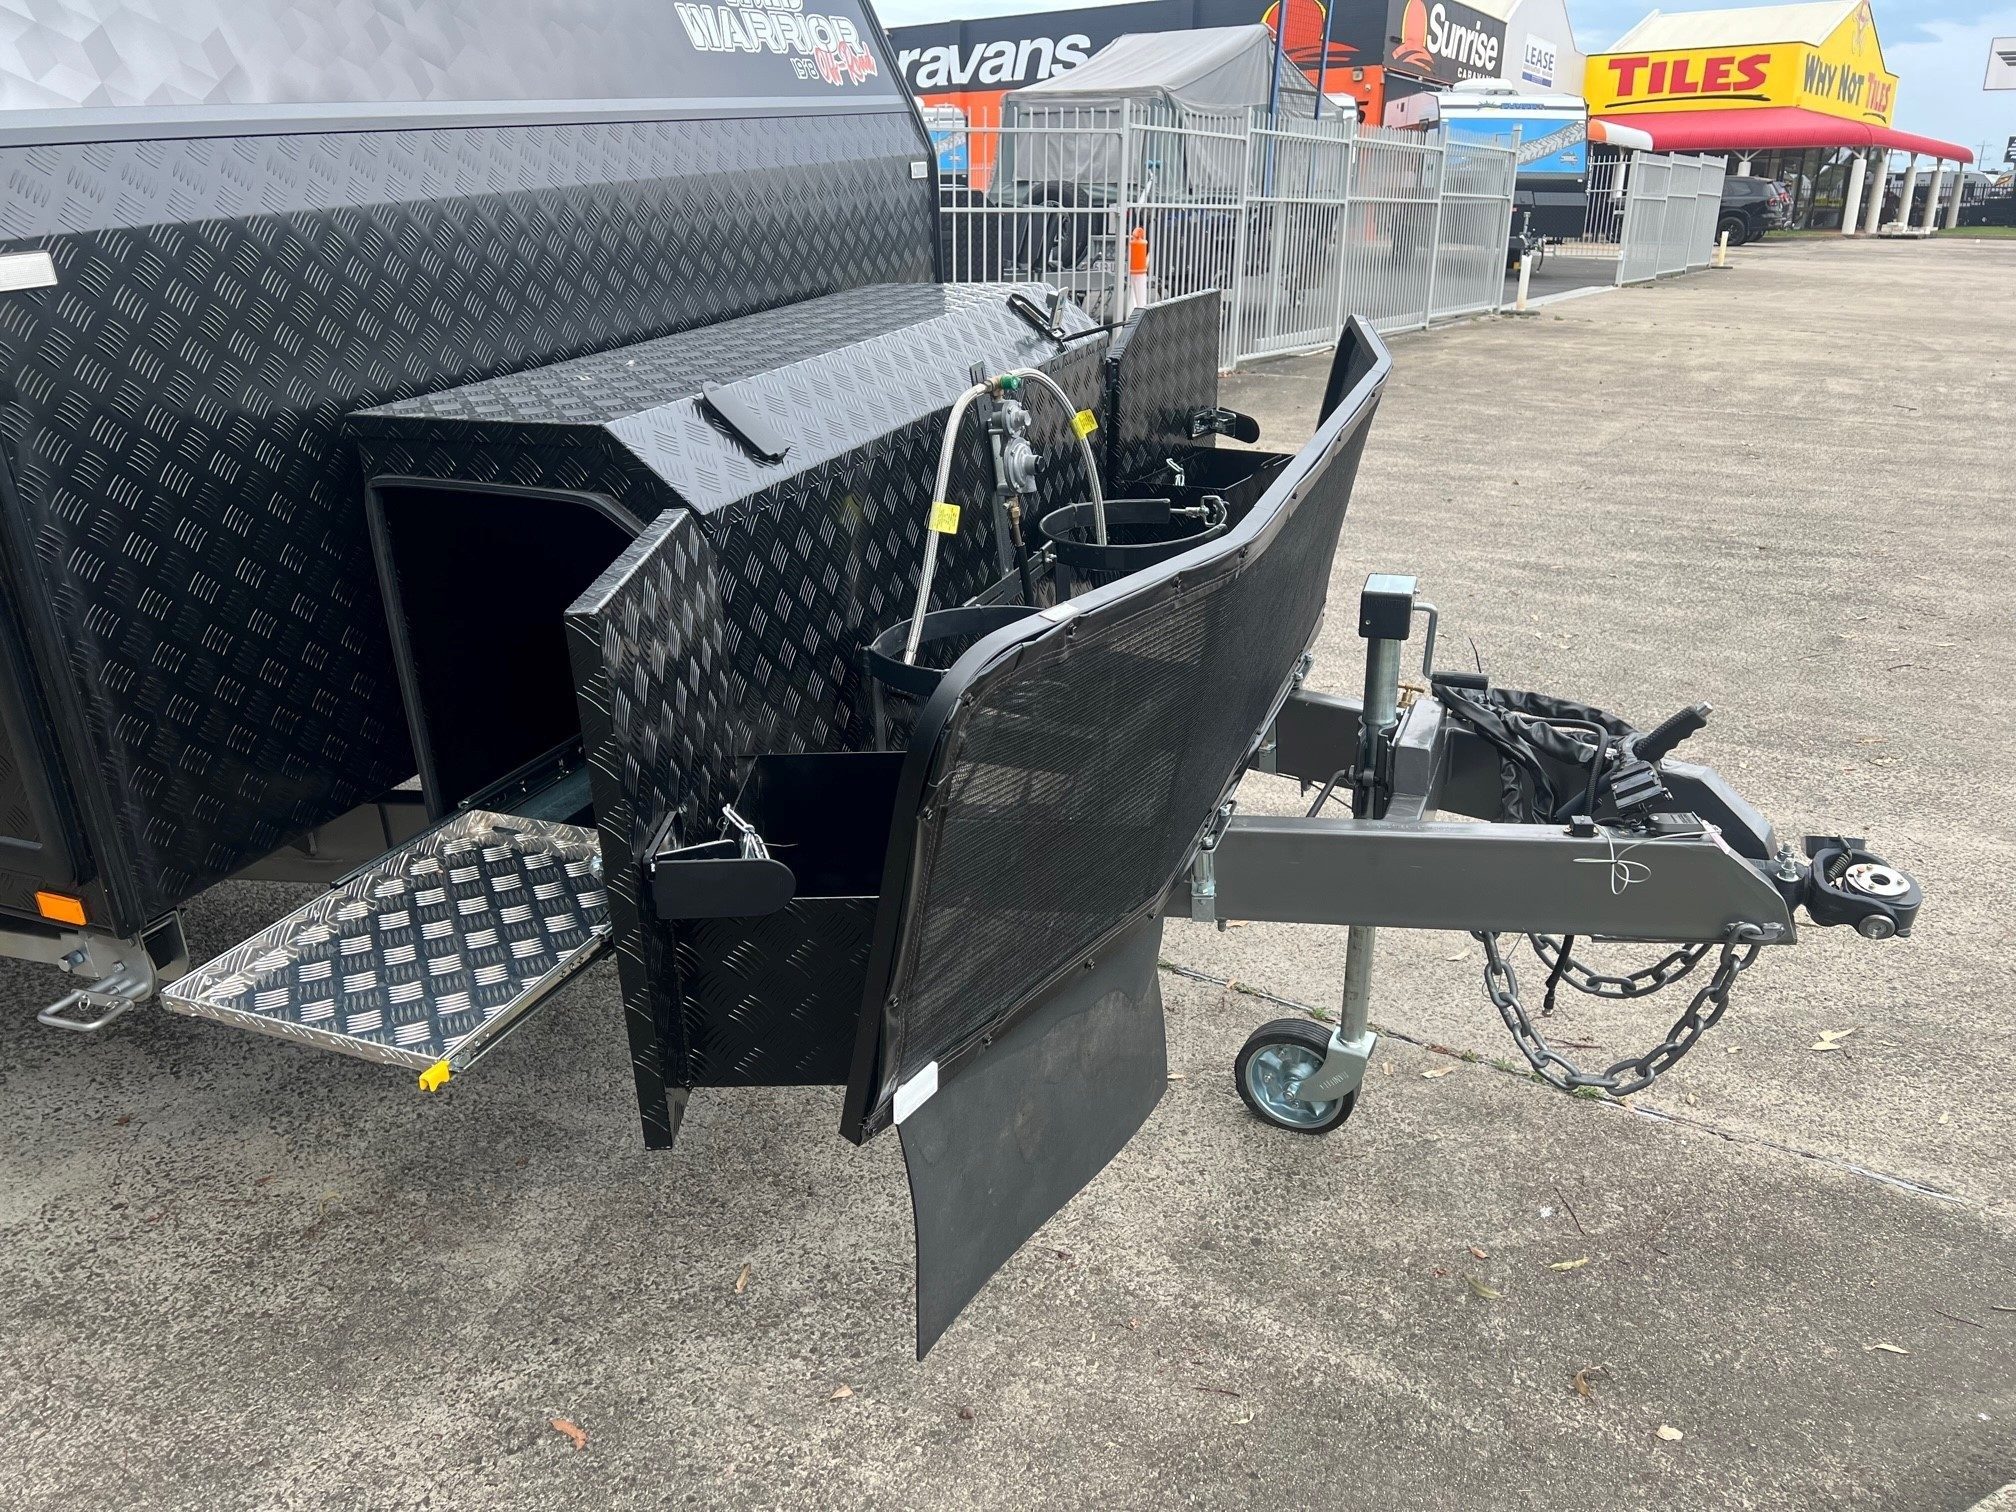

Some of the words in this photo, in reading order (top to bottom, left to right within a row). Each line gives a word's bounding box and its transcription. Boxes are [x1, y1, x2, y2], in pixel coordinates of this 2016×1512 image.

[674, 2, 862, 55] WARRIOR
[1427, 3, 1498, 71] Sunrise
[1525, 44, 1554, 71] LEASE
[1608, 53, 1772, 97] TILES
[1803, 52, 1838, 99] WHY
[1837, 62, 1865, 106] NOT
[1865, 71, 1892, 113] TILES
